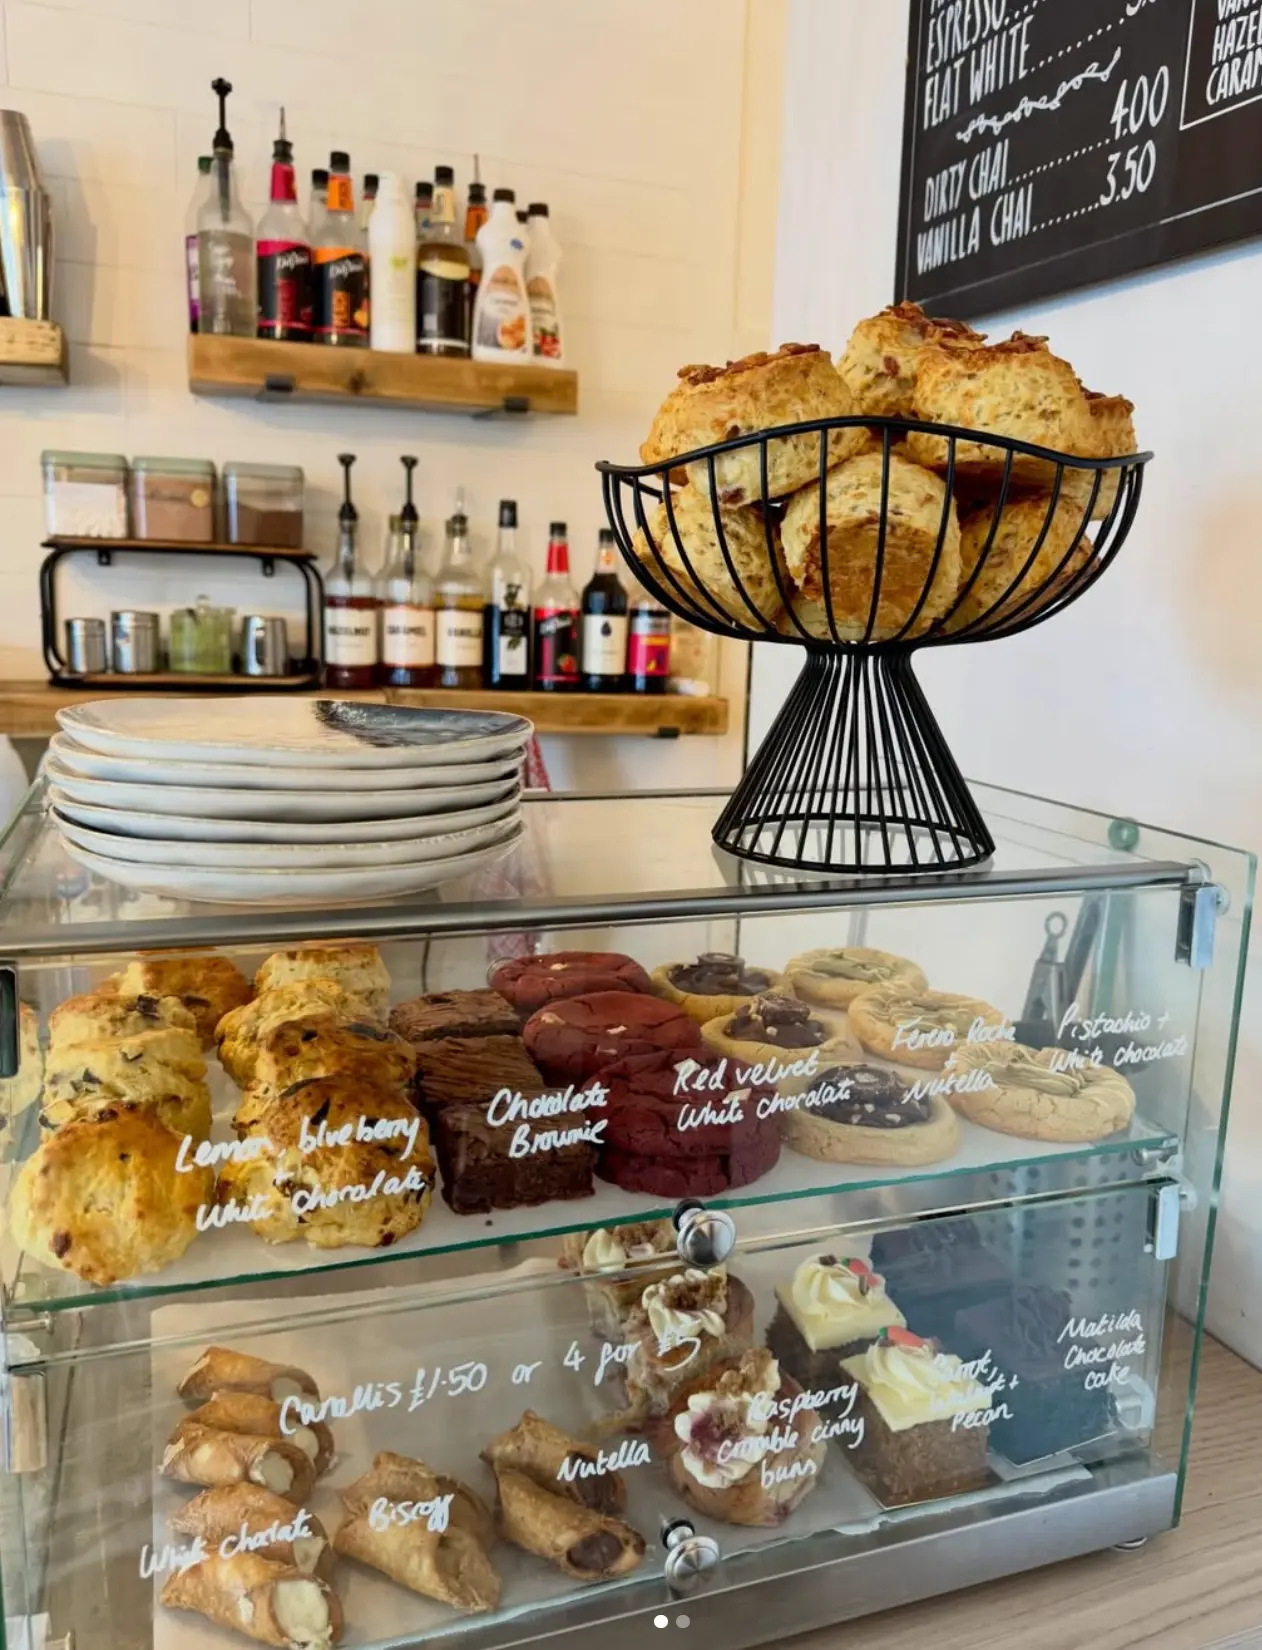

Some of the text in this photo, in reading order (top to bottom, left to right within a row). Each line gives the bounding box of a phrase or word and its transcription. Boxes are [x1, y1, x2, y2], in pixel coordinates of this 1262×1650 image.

[924, 57, 965, 131] FLAT
[970, 15, 1034, 106] WHITE
[924, 159, 967, 222] DIRTY
[969, 138, 1009, 201] CHAI
[917, 139, 1156, 276] VANILLA CHAI 3.50
[673, 1049, 821, 1096] Red velvet
[508, 1119, 609, 1159] Brownie
[511, 1361, 543, 1384] or
[563, 1340, 586, 1372] 4
[594, 1340, 643, 1386] for
[556, 1440, 651, 1481] Nutella
